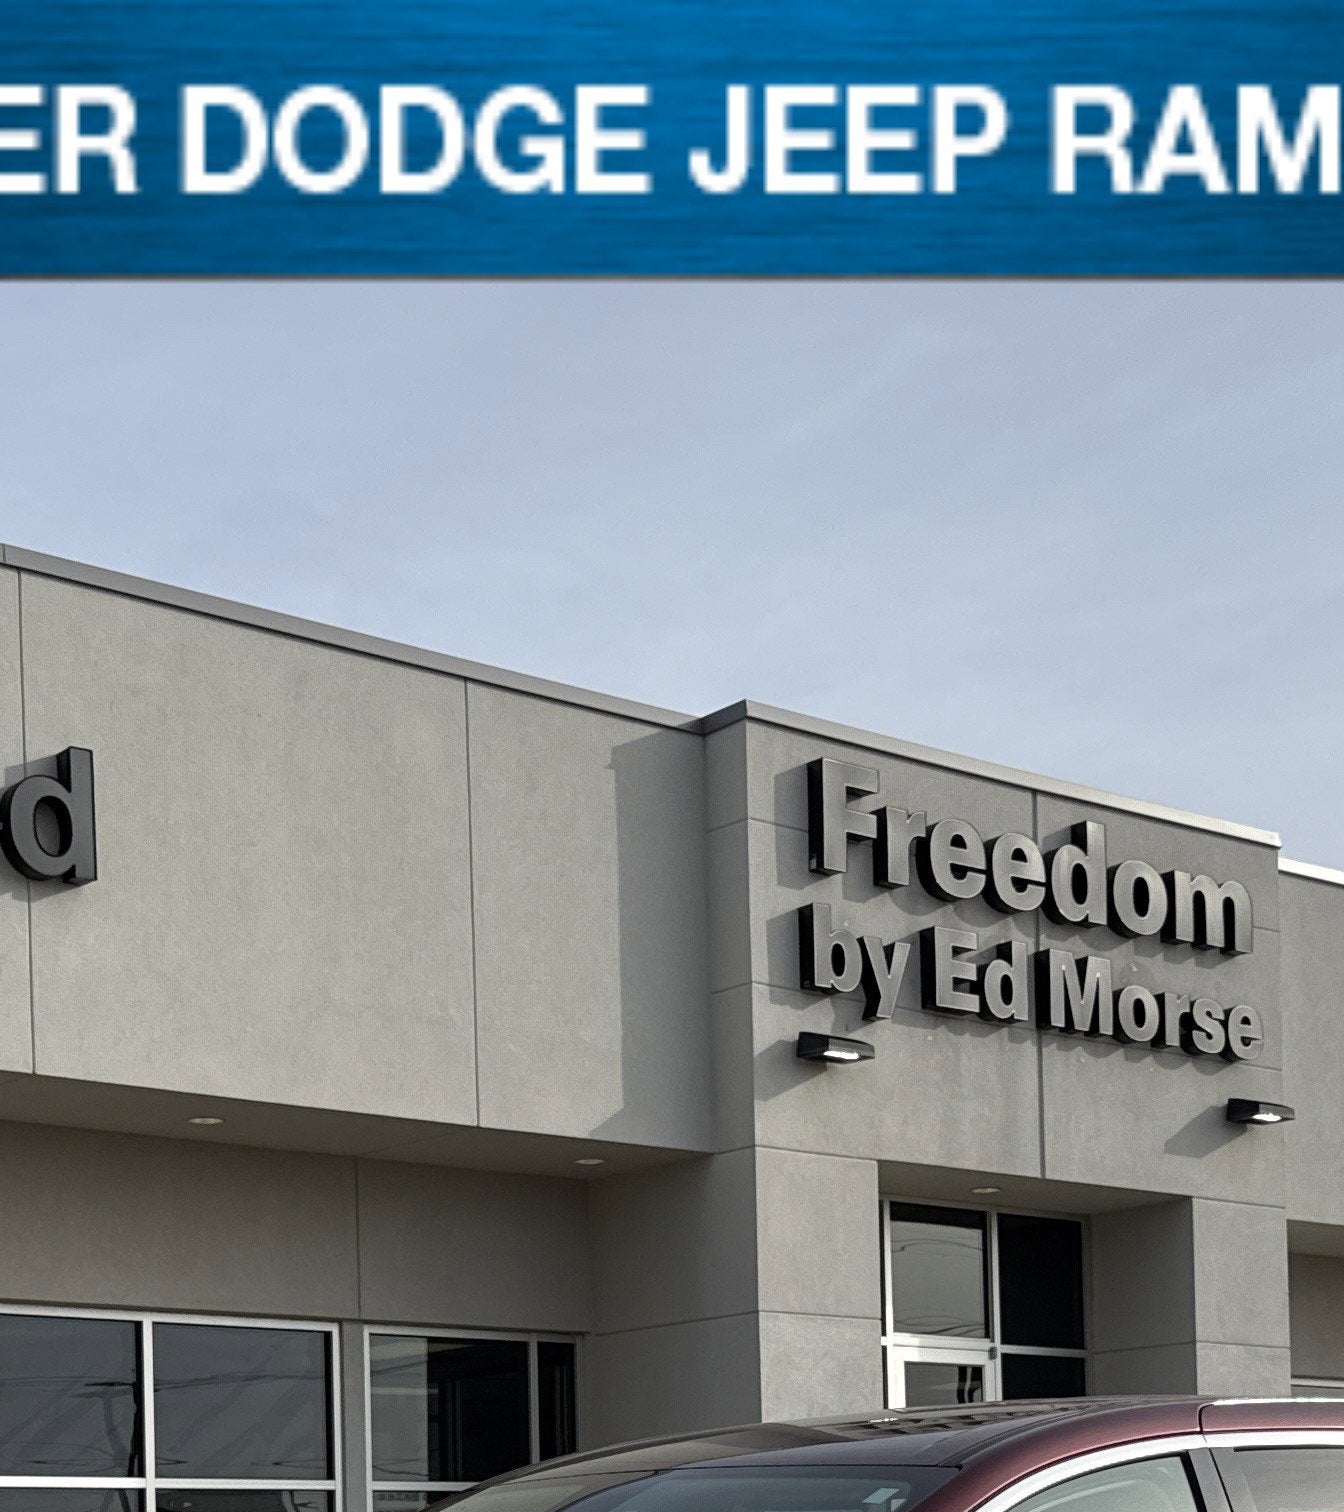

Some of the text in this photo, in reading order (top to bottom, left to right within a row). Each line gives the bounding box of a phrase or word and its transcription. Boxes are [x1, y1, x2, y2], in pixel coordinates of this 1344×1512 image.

[807, 757, 1253, 954] Freedom
[799, 902, 1264, 1062] by Ed Morse
